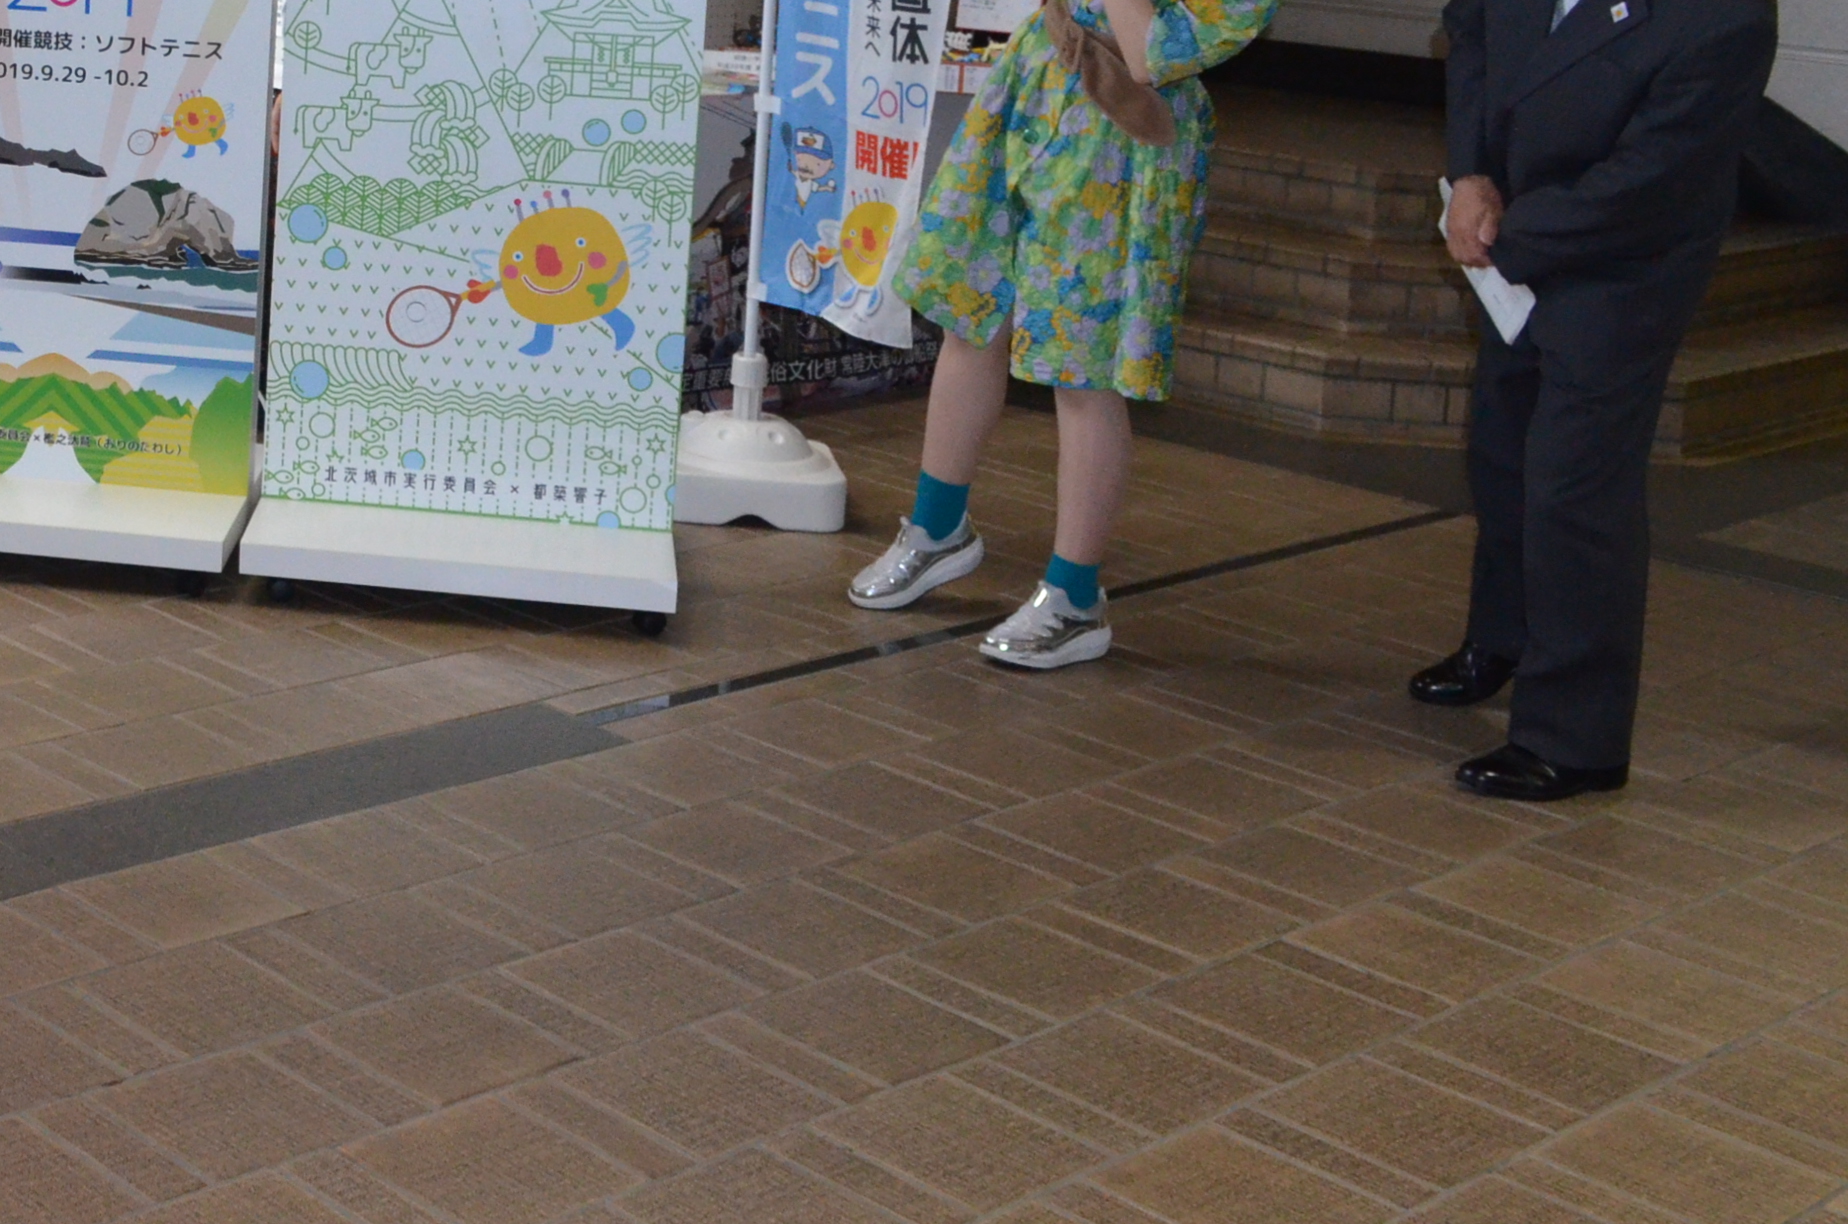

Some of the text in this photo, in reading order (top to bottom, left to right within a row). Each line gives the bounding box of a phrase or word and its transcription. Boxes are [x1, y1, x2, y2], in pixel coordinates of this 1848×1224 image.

[861, 75, 928, 127] 2019
[324, 466, 497, 496] 北茨城市実行委員会
